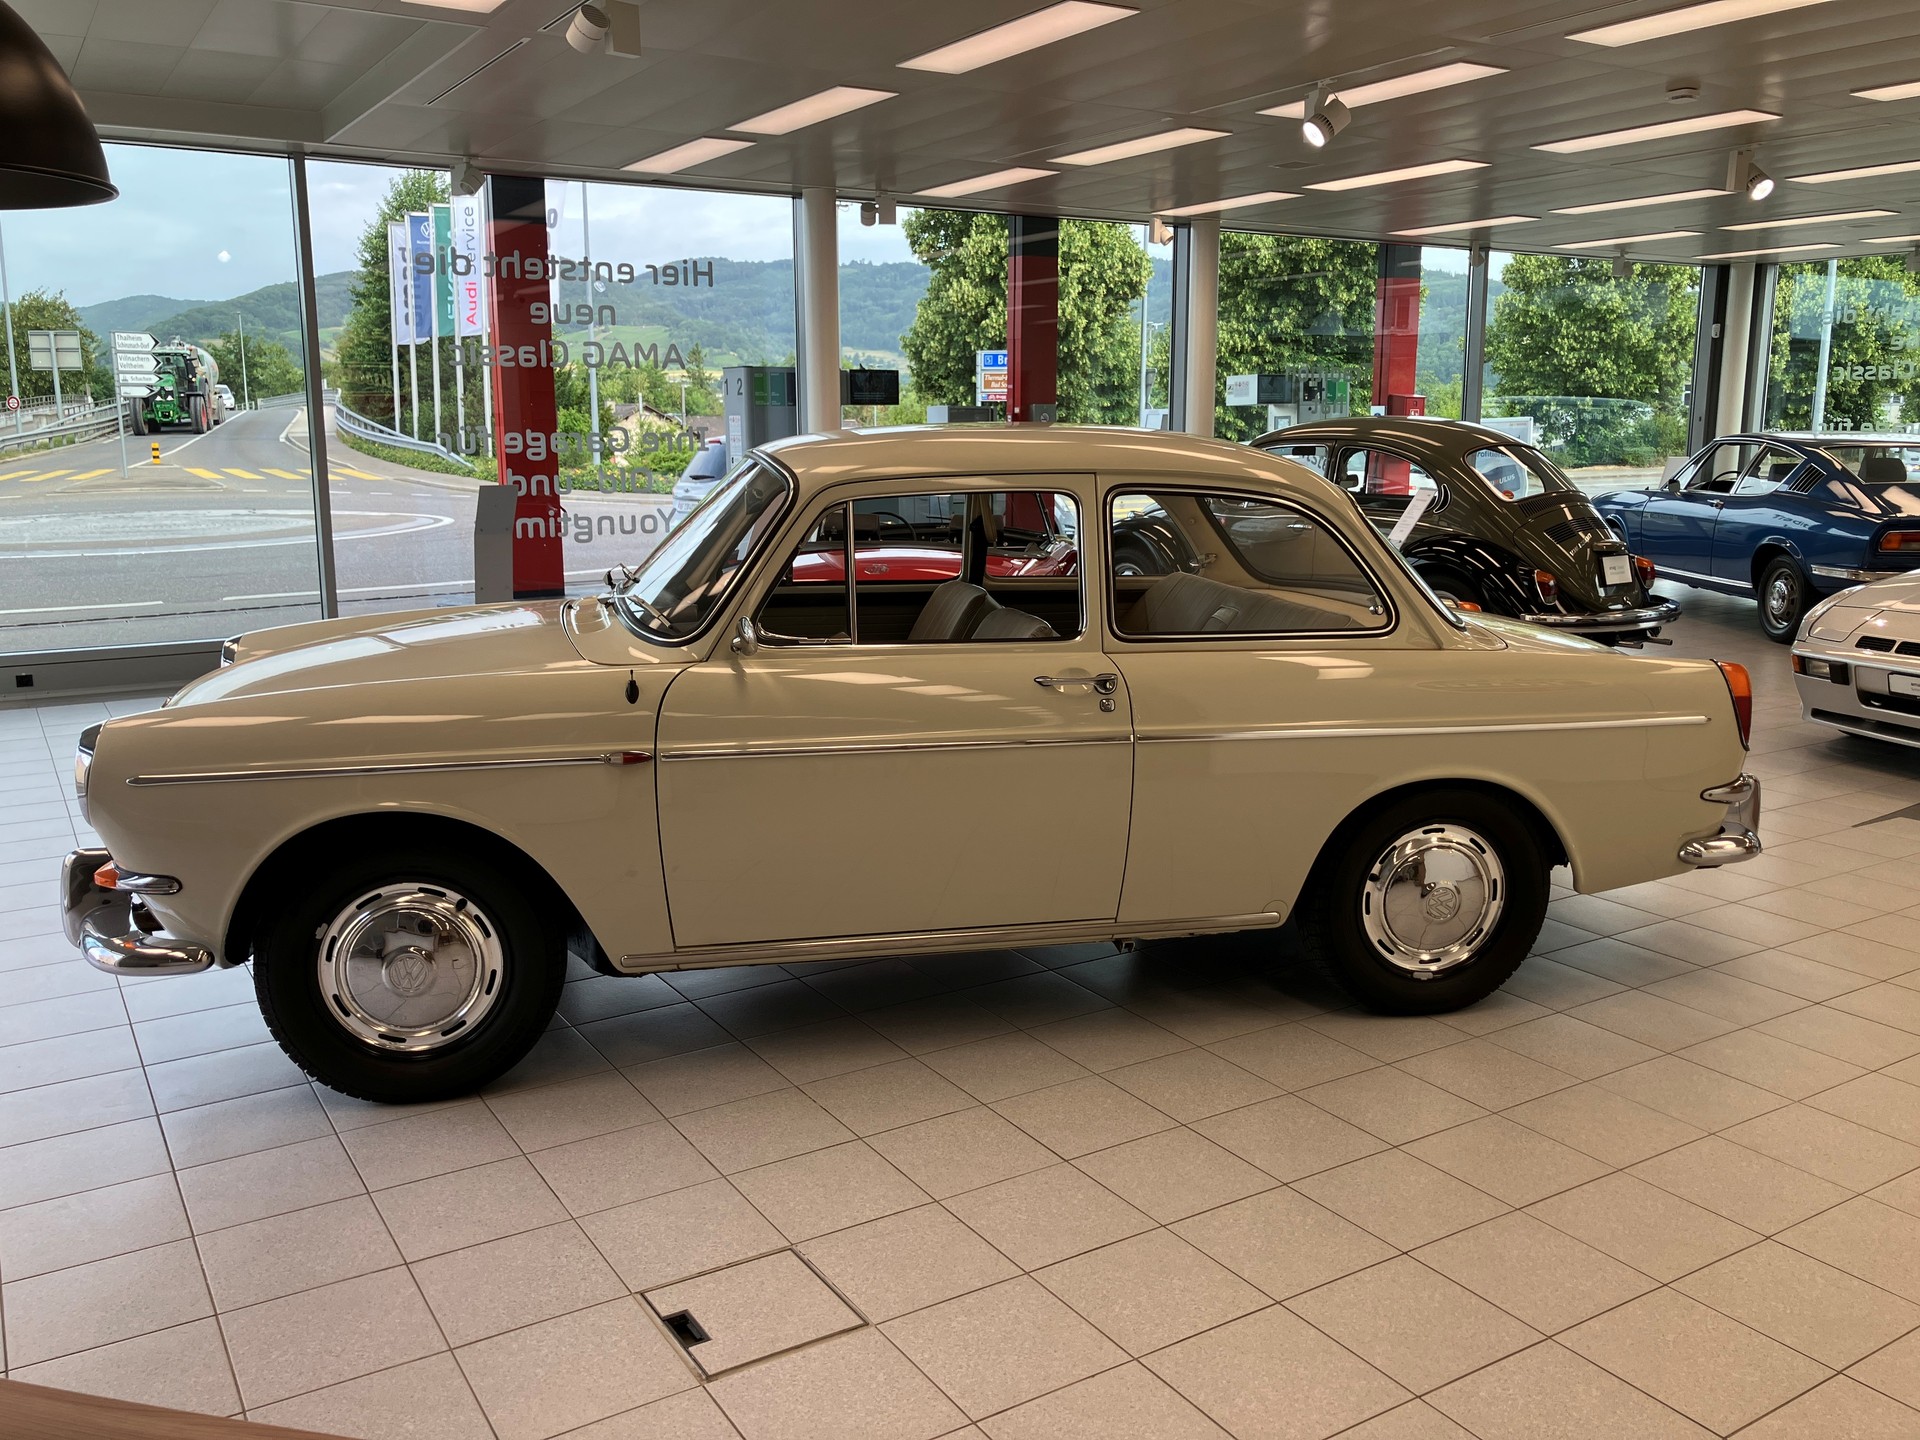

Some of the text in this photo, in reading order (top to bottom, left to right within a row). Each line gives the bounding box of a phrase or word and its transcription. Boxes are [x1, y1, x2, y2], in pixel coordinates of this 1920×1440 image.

[466, 281, 479, 326] Audi
[118, 354, 150, 362] Villnachern
[723, 377, 730, 396] 1
[736, 377, 743, 396] 2
